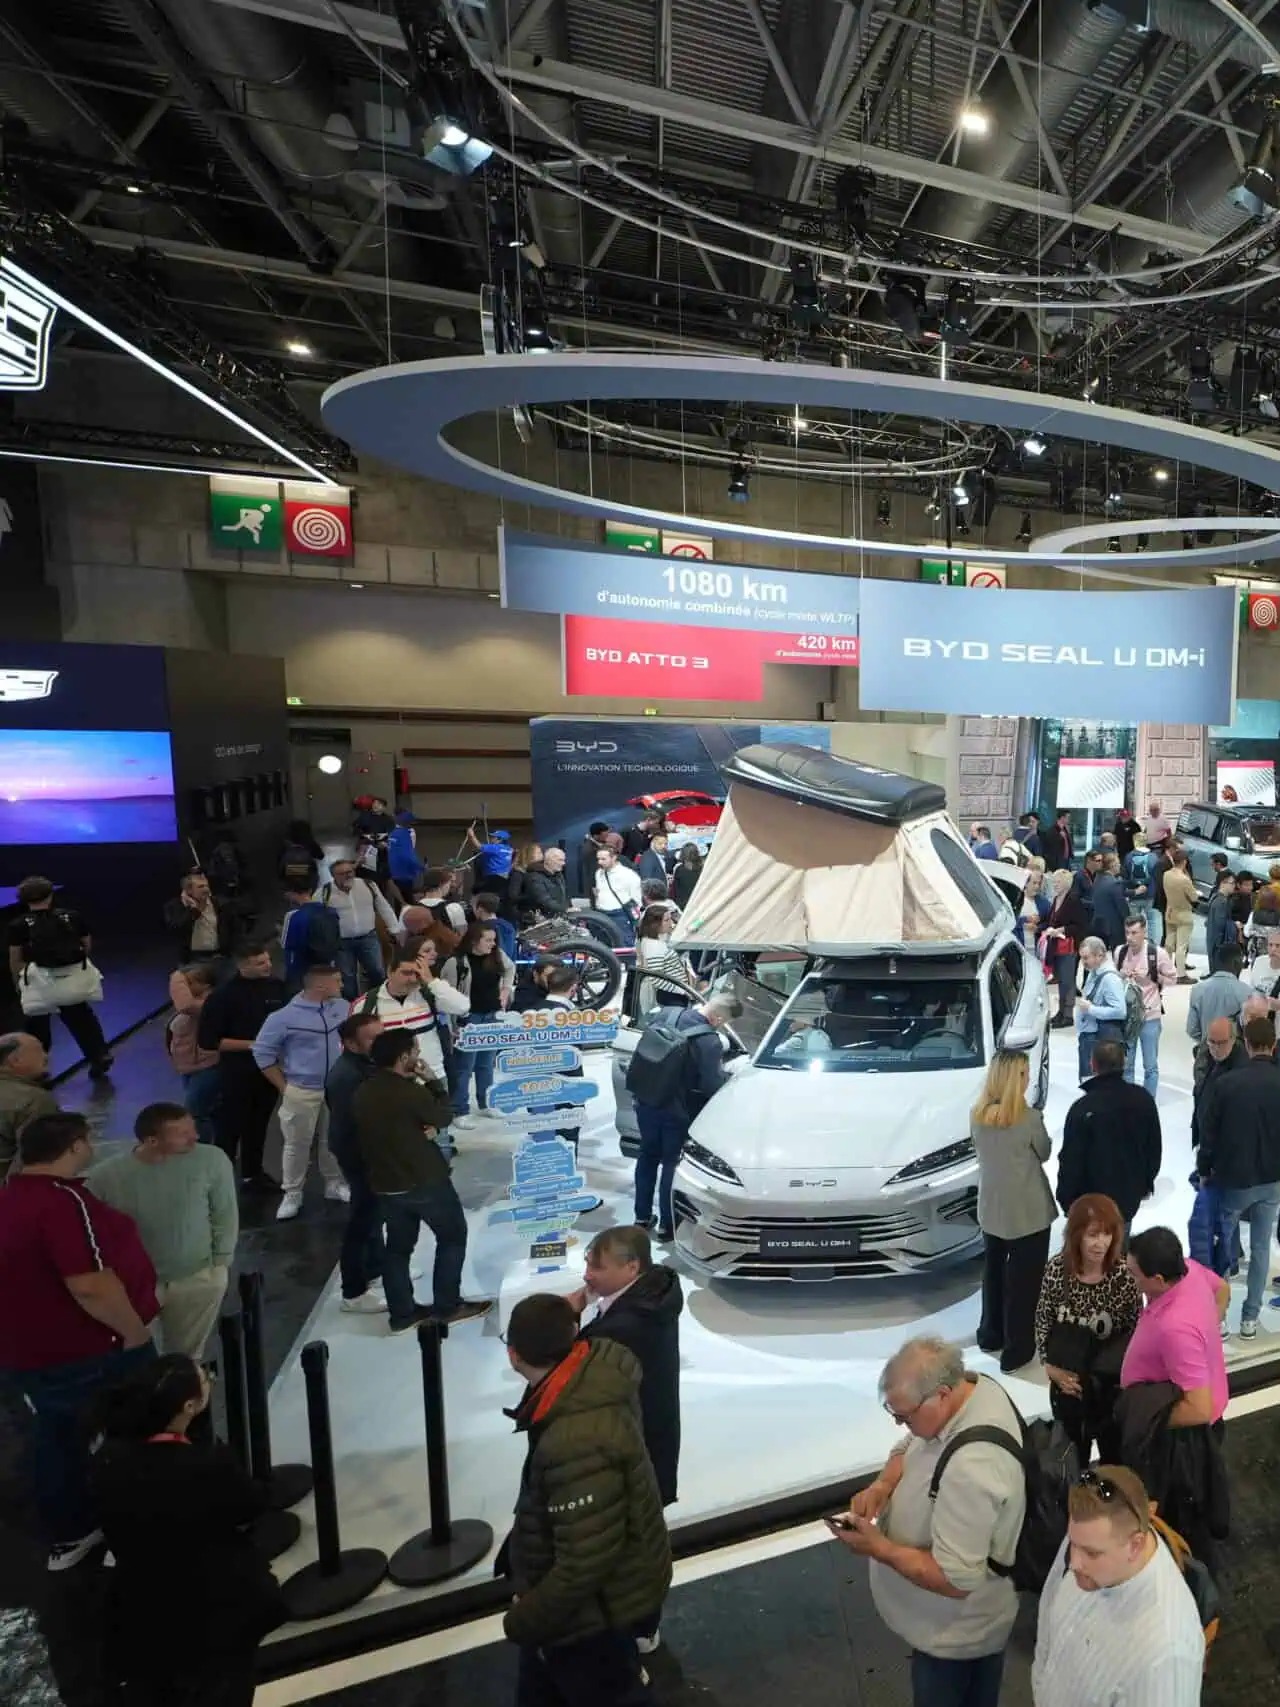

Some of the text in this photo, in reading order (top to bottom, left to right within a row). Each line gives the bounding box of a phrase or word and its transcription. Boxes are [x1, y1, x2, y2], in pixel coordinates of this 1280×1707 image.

[662, 567, 788, 604] 1080 km
[797, 635, 856, 650] 420 km
[585, 647, 709, 669] BYD ATTO 3
[903, 638, 1206, 668] BYD SEAL U DM-i
[556, 740, 618, 753] BYD
[624, 763, 700, 773] TECHNOLOGIQUE
[521, 1013, 548, 1029] 35
[468, 1035, 496, 1046] BYD
[500, 1032, 534, 1043] SEAL
[537, 1031, 548, 1041] U
